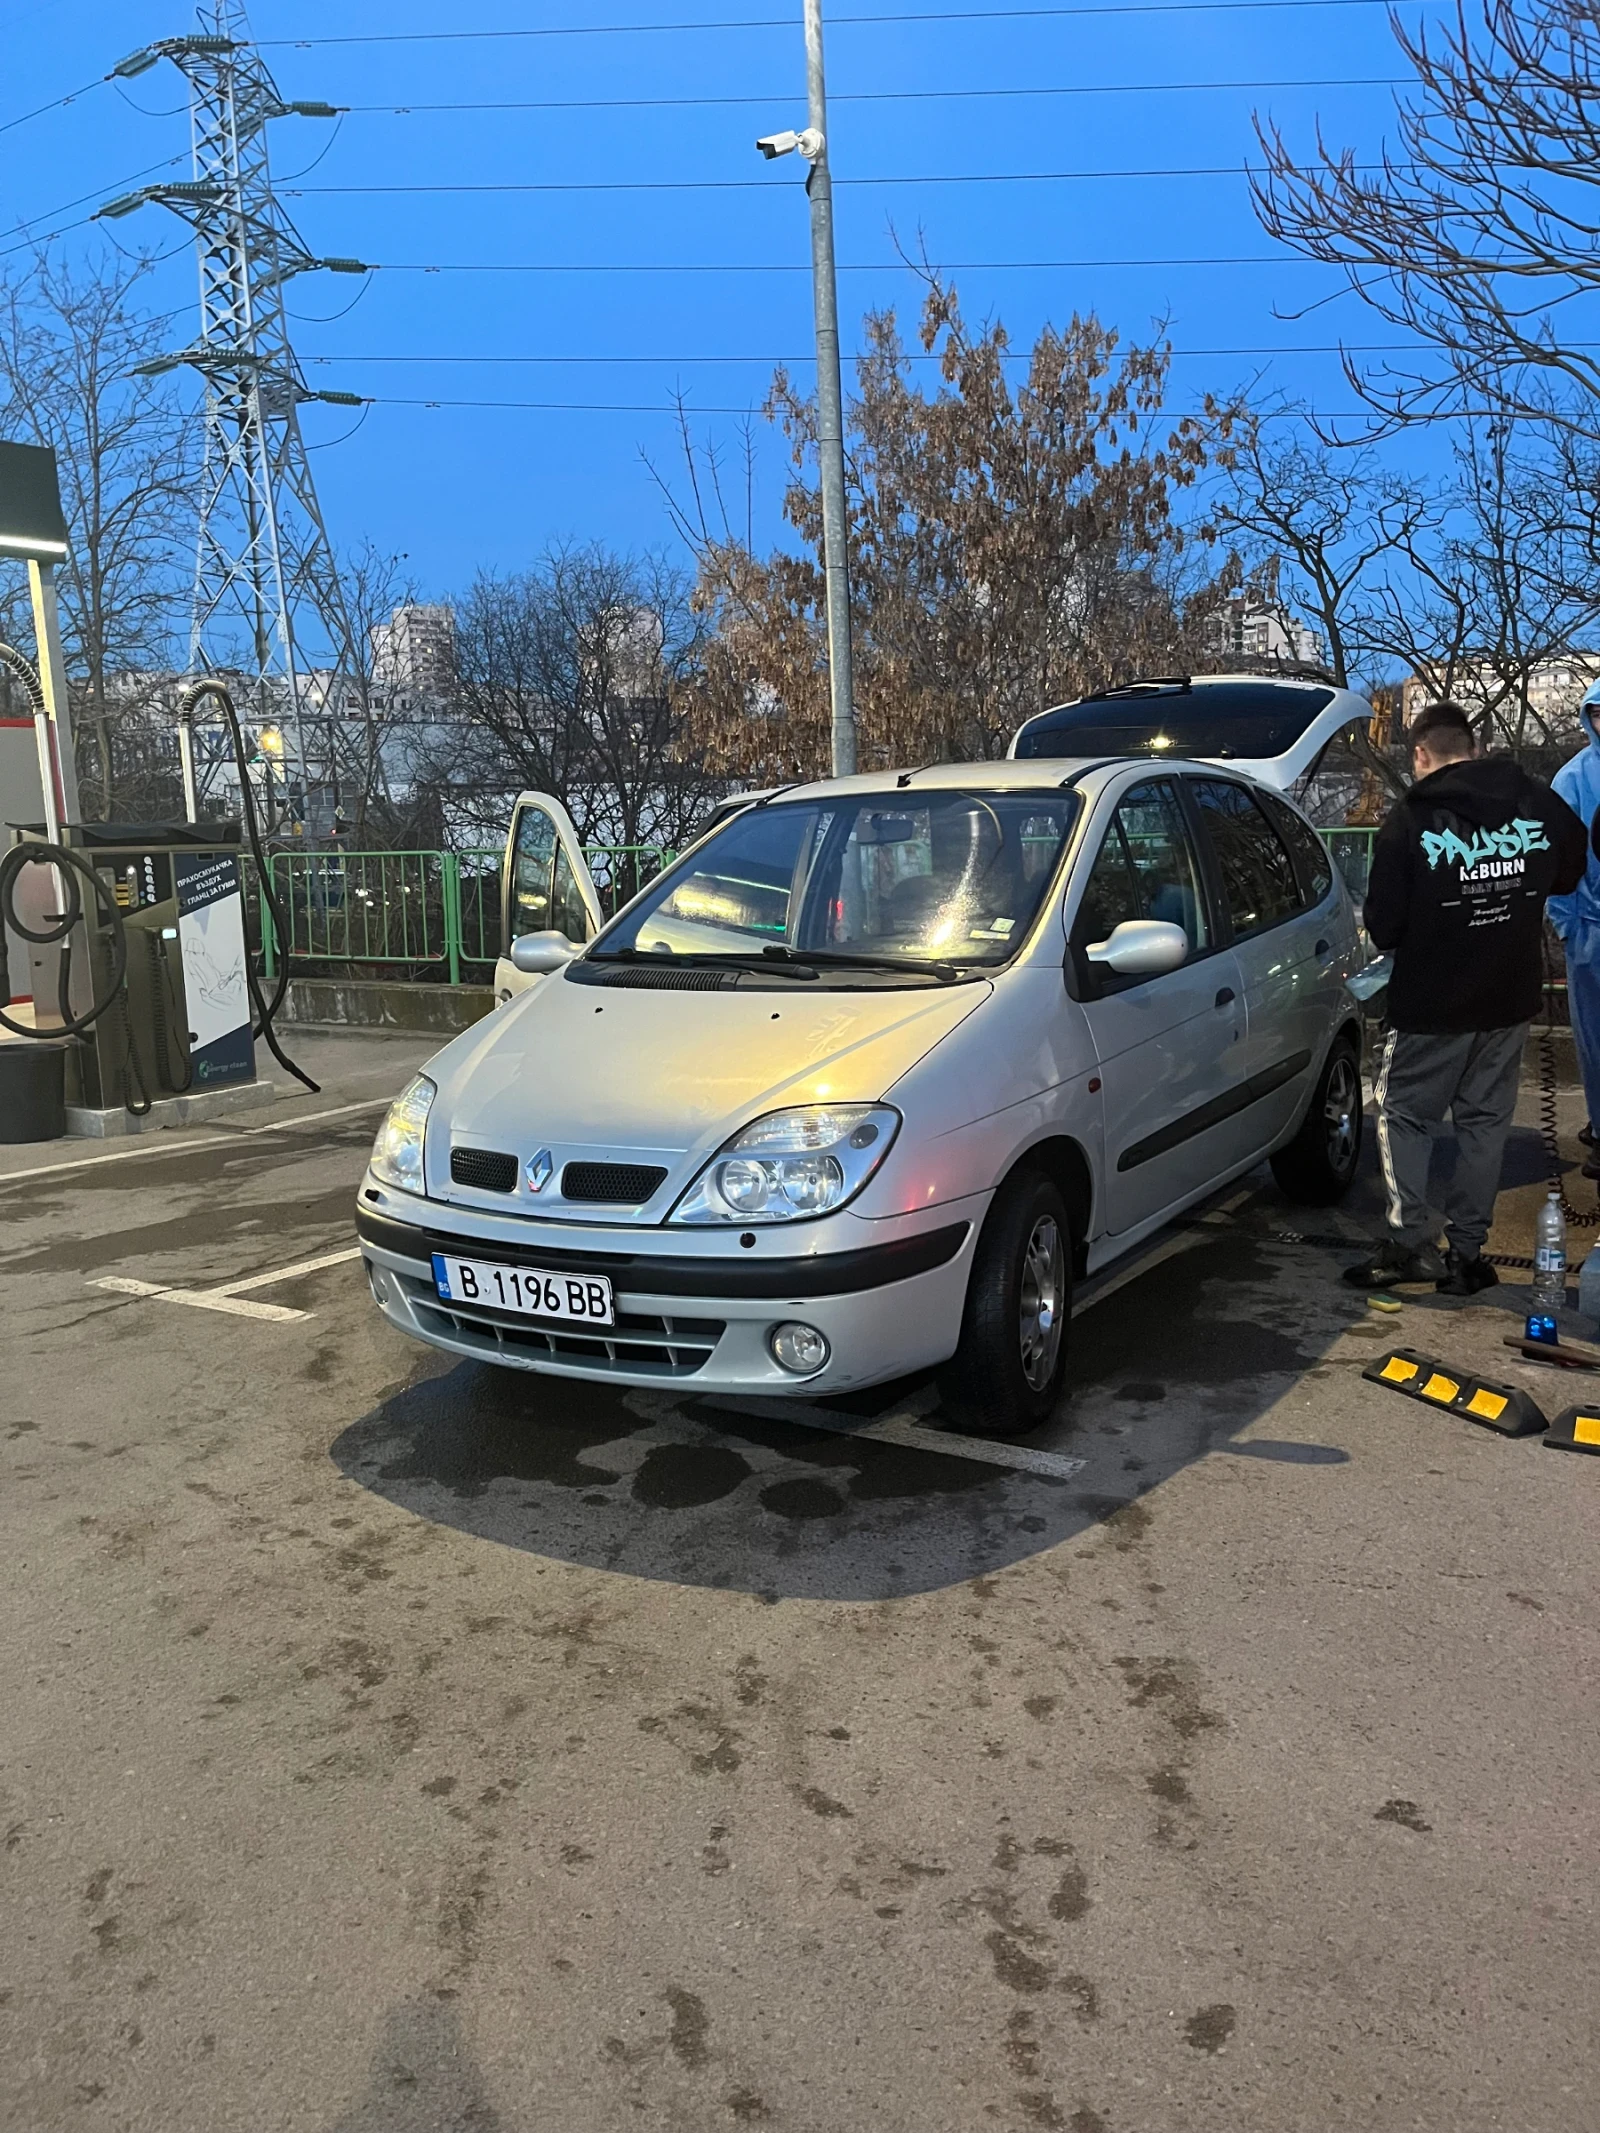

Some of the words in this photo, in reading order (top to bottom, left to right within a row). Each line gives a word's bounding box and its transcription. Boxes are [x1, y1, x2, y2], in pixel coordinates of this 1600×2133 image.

[1420, 817, 1551, 870] PAUSE
[176, 859, 233, 887] ПРАХОСМУКАЧКА
[195, 875, 222, 891] ВЪЗДУХ
[187, 891, 211, 905] ГЛАНЦ
[210, 887, 218, 896] ЗА
[218, 879, 236, 892] ГУМИ
[438, 1281, 450, 1293] BG
[459, 1265, 479, 1298] B
[494, 1271, 560, 1311] 1196
[565, 1280, 607, 1318] BB
